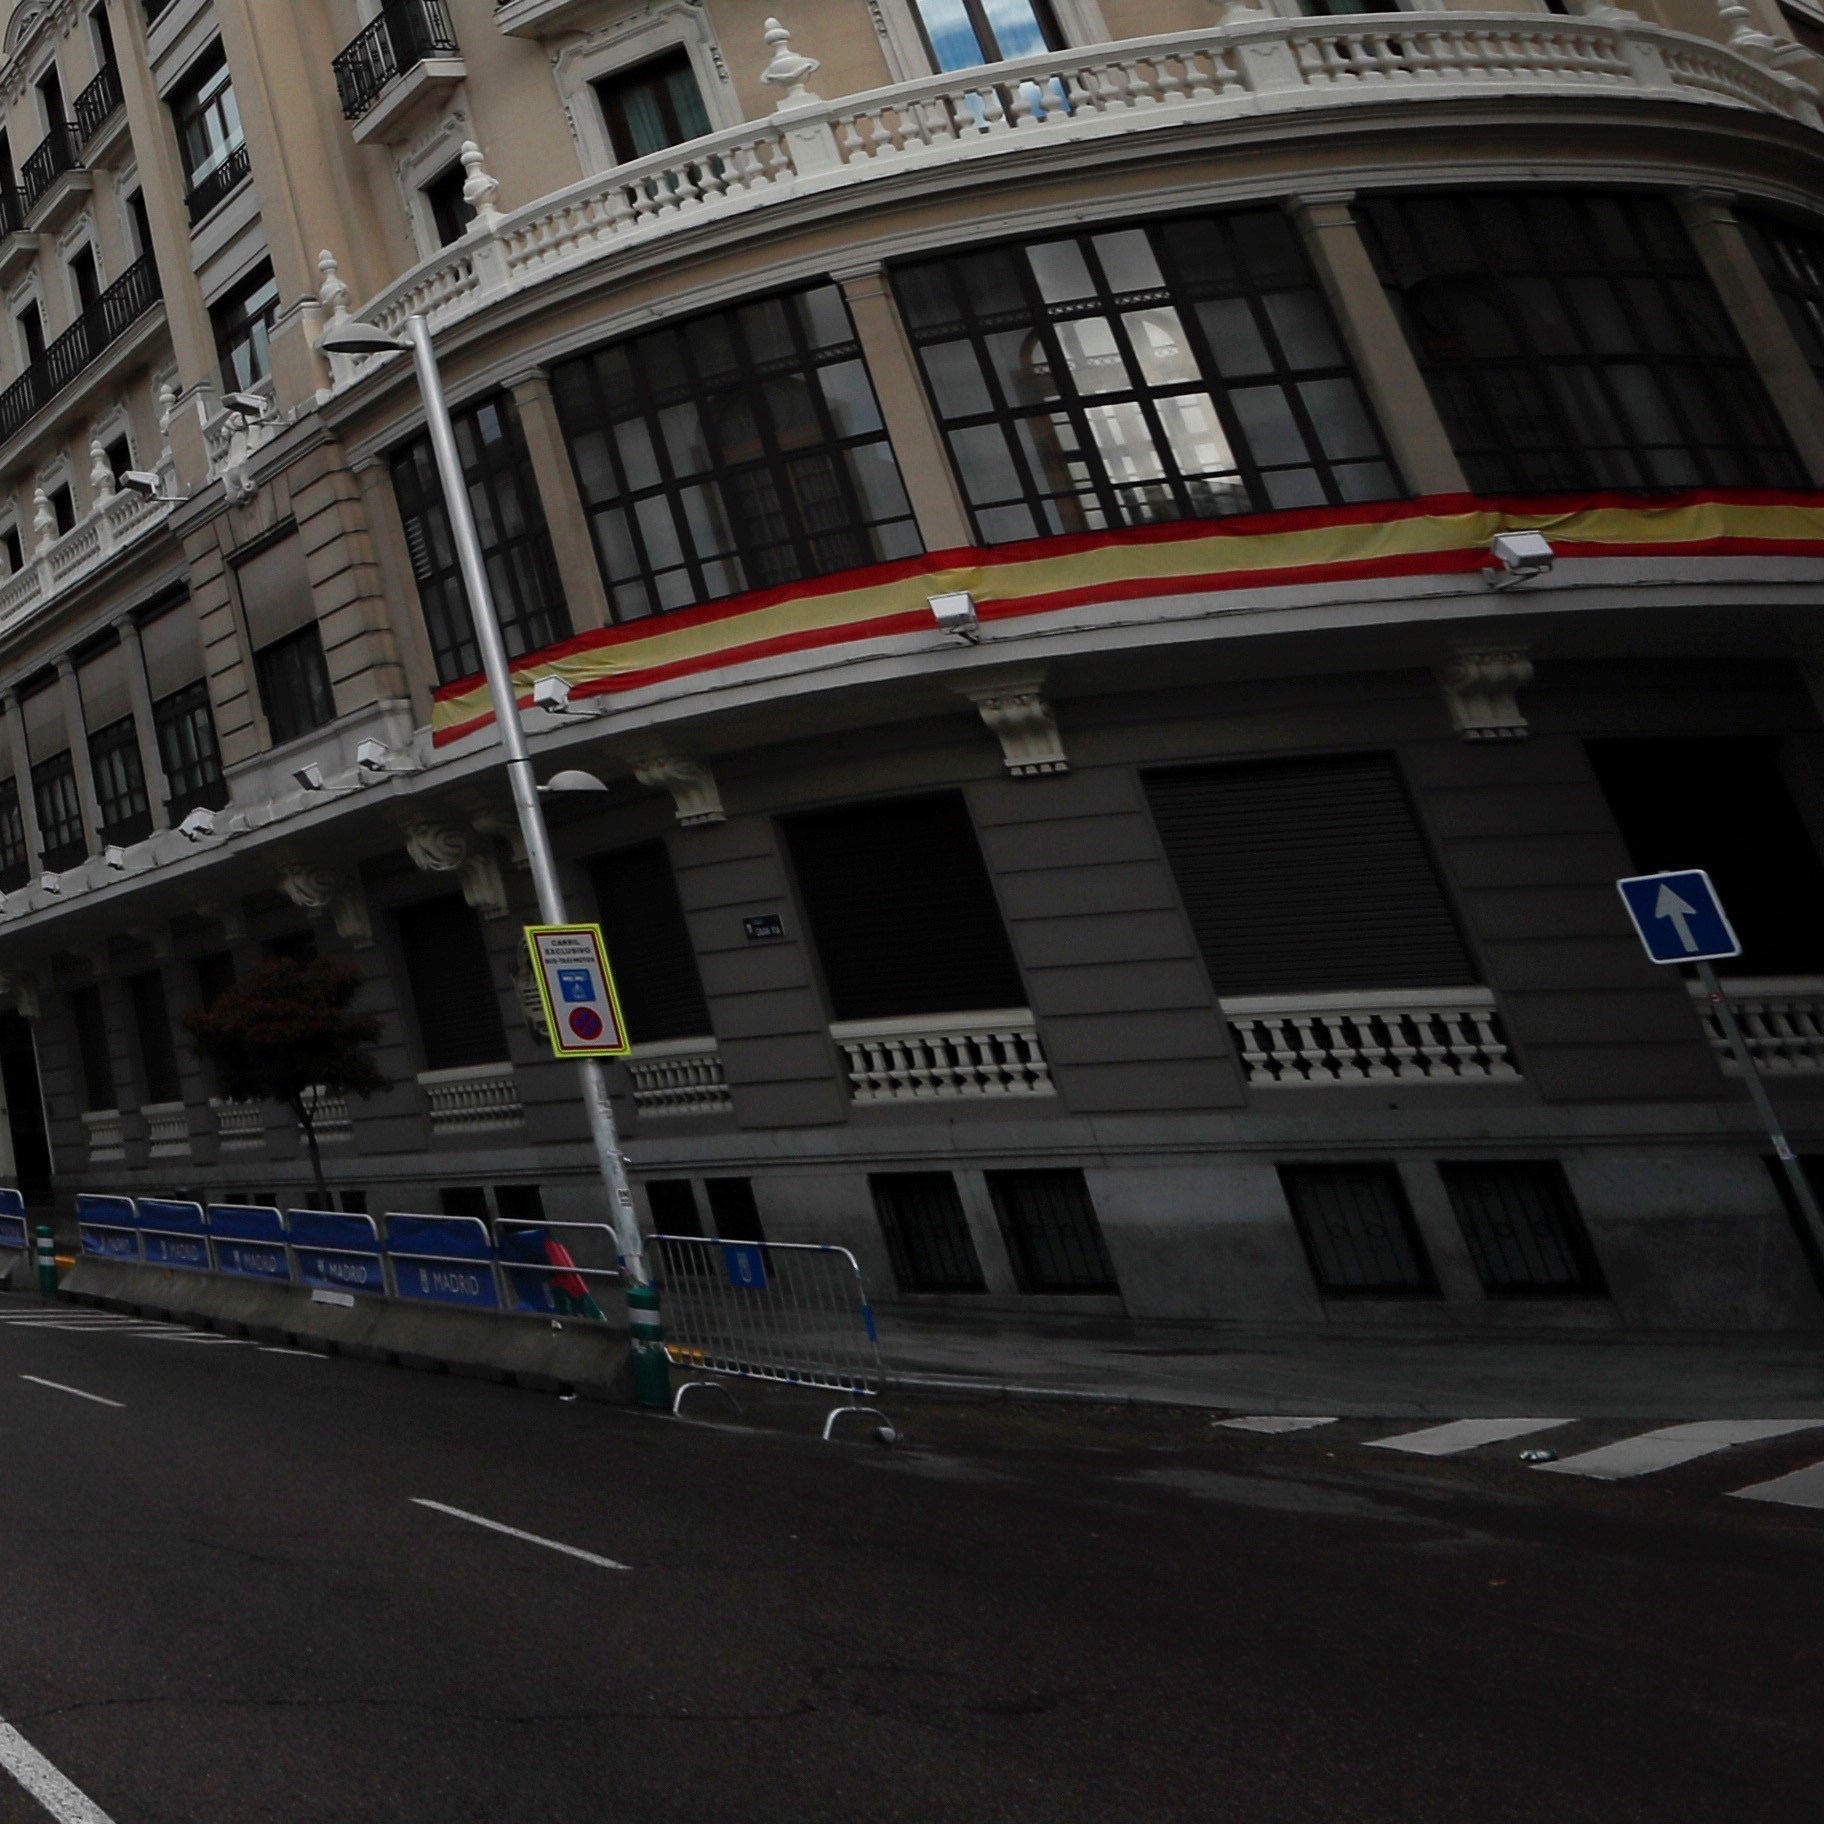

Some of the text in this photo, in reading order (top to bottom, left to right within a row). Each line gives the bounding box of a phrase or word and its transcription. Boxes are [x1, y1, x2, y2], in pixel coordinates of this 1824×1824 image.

[545, 947, 591, 955] EXCLUSIVO
[245, 1253, 276, 1273] MADRID
[329, 1264, 368, 1285] MADRID
[433, 1273, 479, 1296] MADRID
